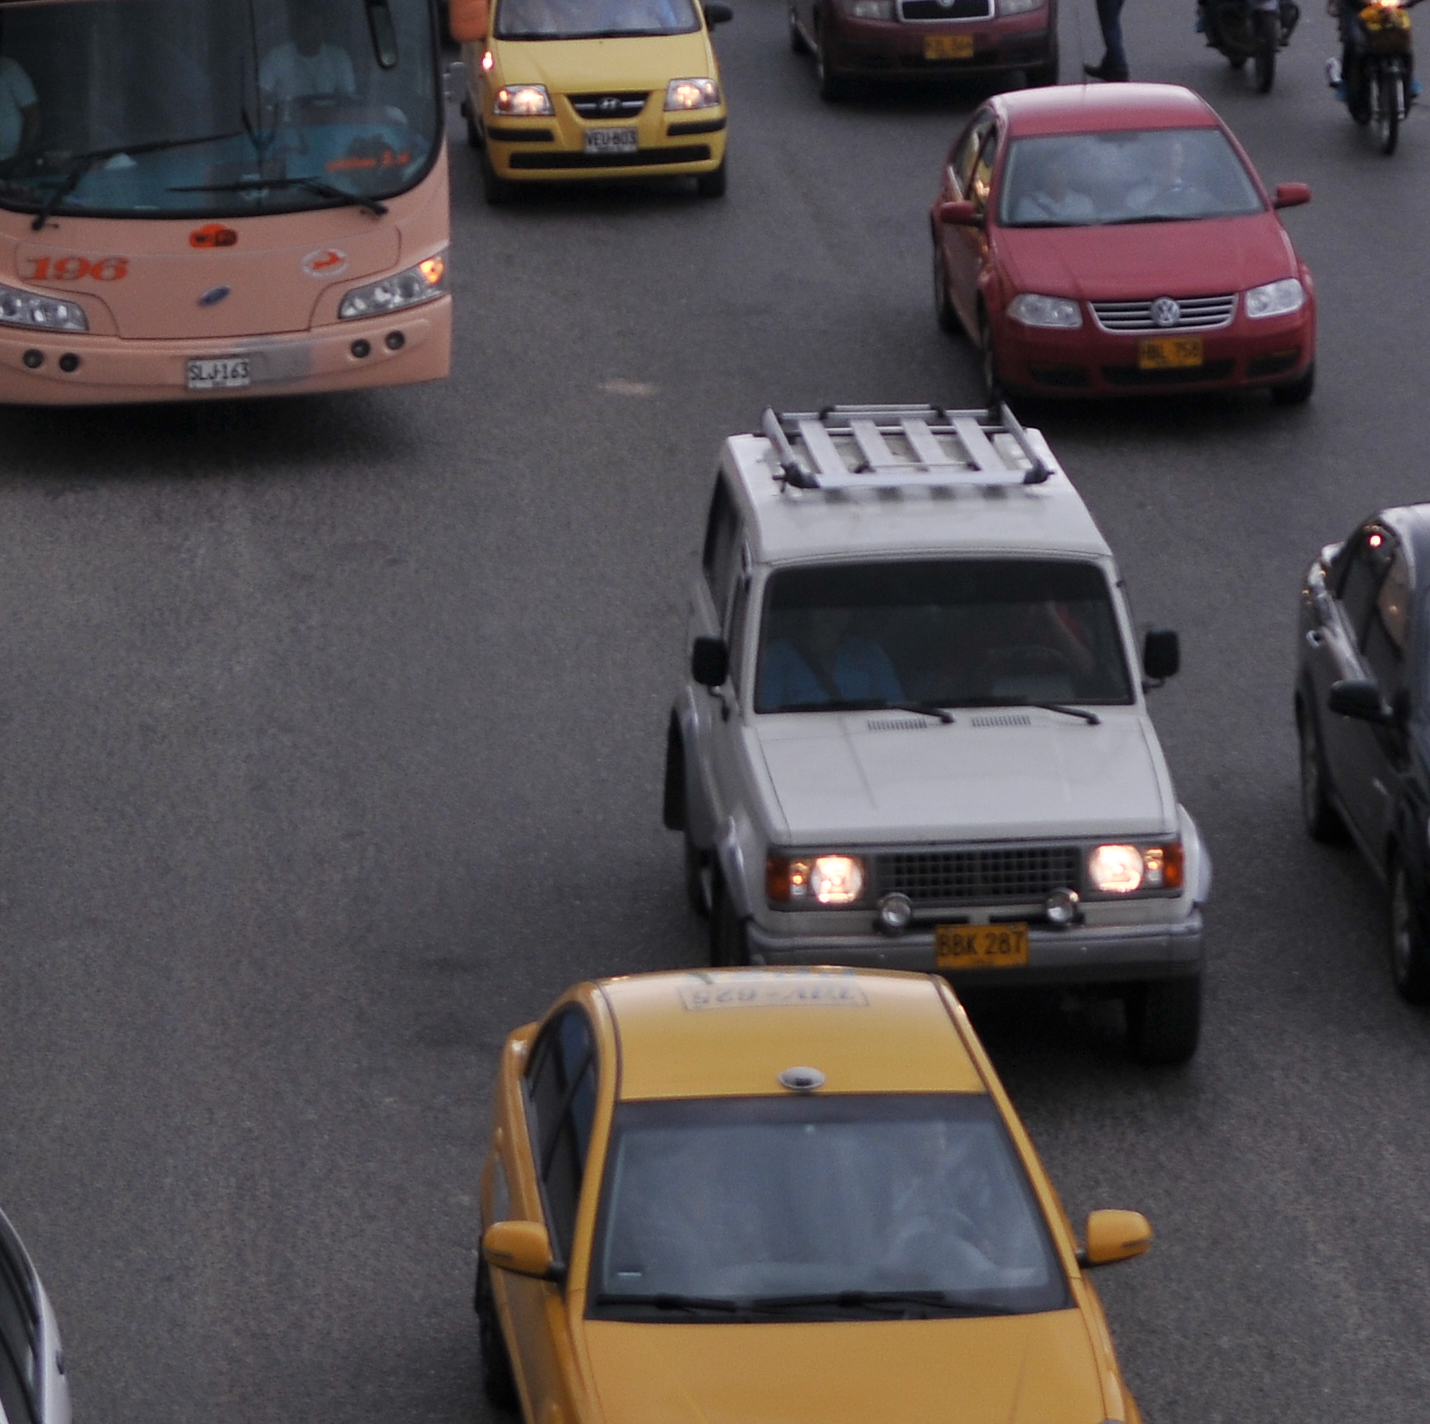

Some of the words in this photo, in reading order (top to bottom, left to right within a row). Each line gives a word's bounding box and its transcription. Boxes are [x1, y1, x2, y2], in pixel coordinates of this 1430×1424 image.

[27, 256, 128, 280] 196
[189, 361, 250, 380] SLJ-163
[984, 932, 1025, 956] 287
